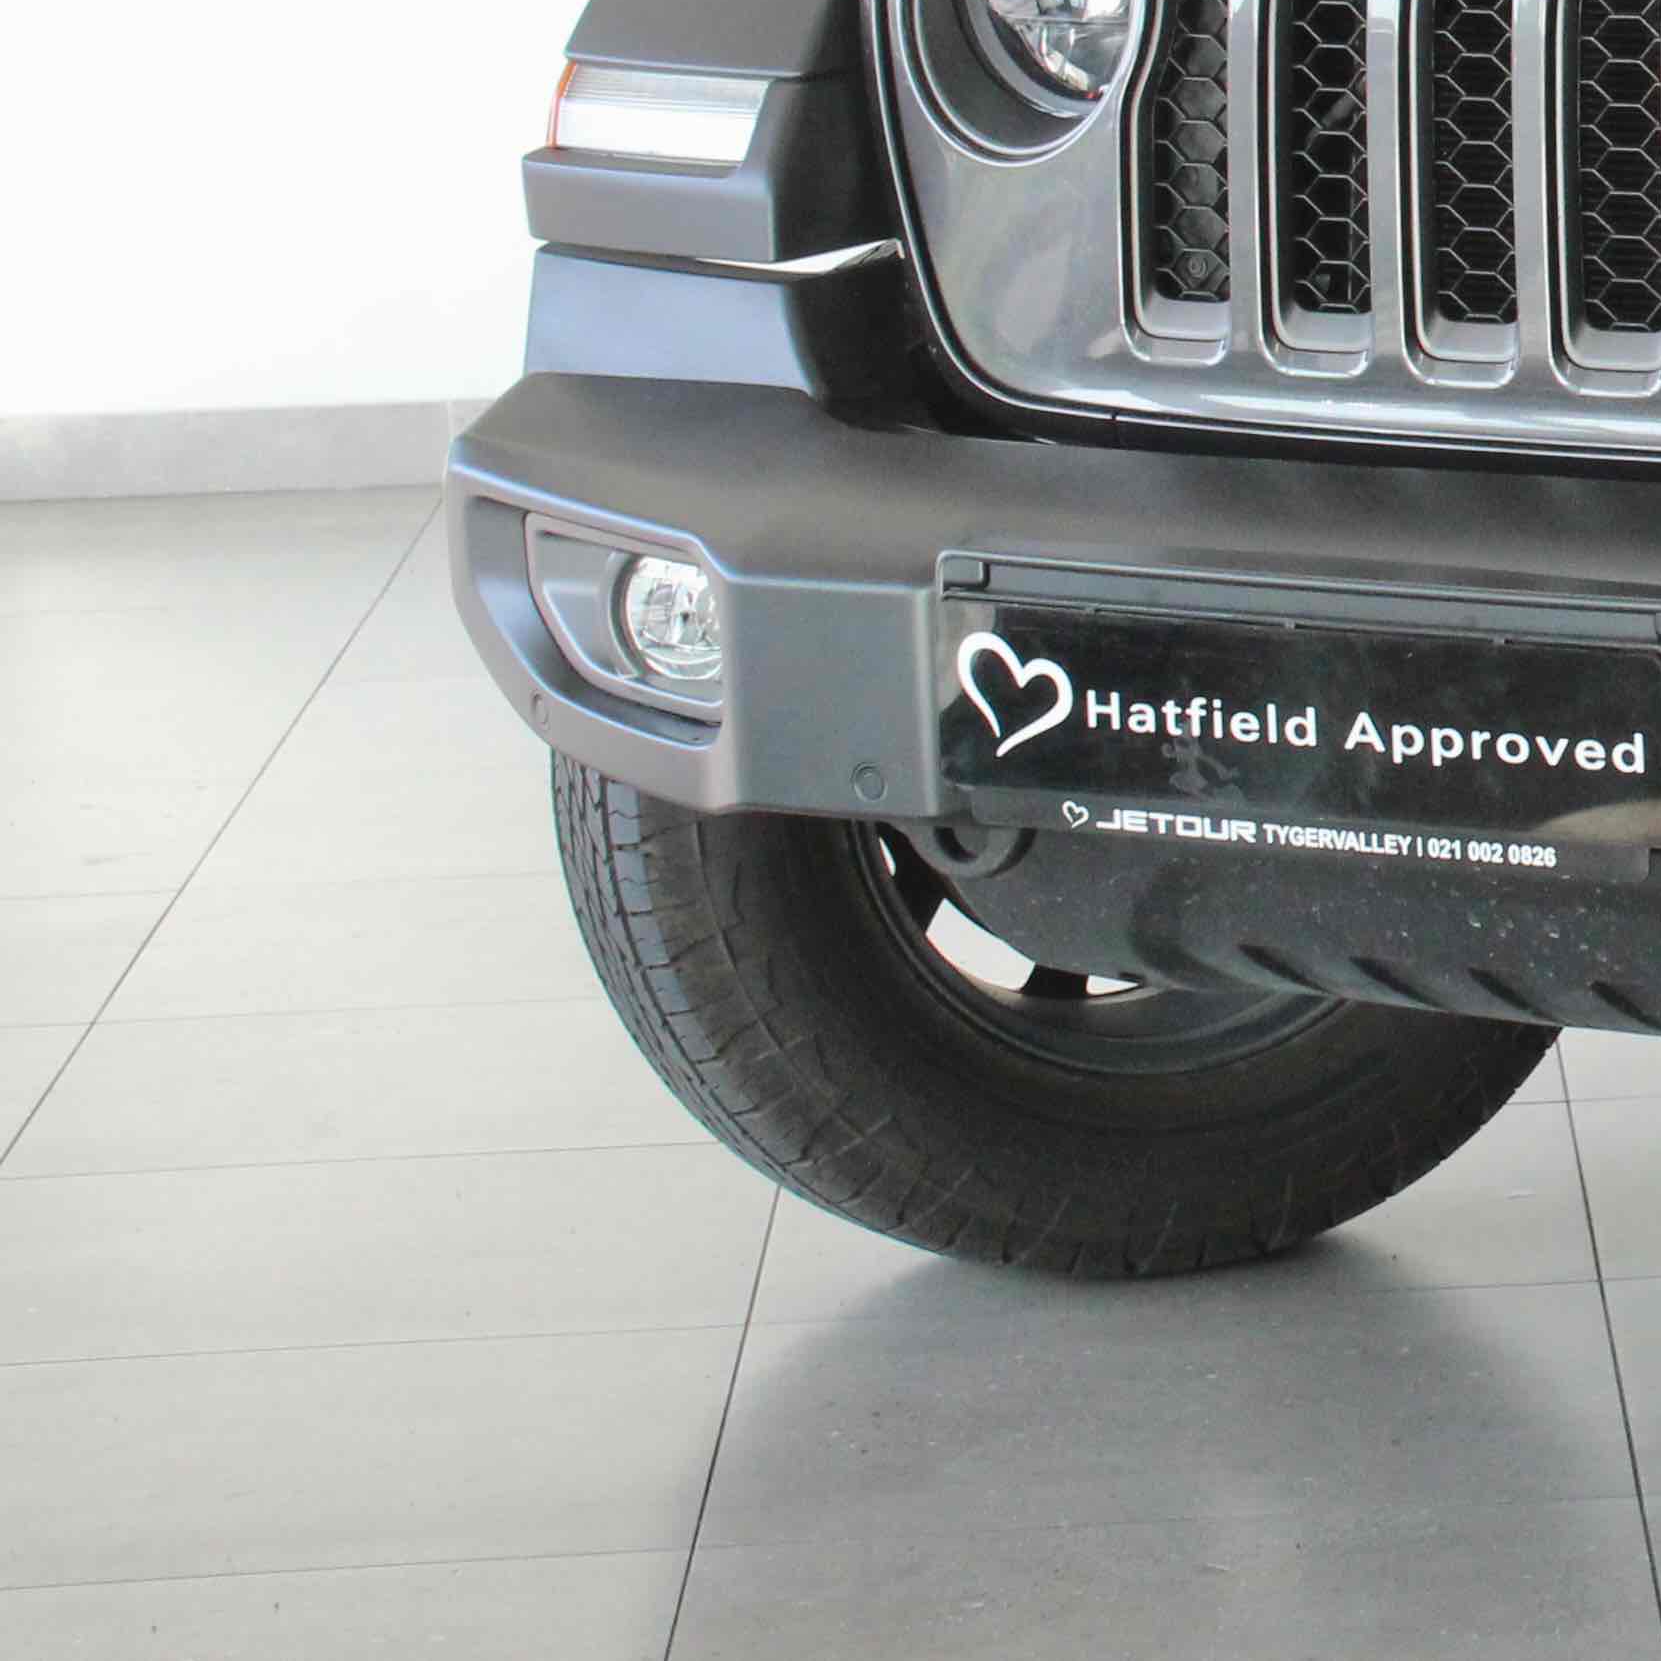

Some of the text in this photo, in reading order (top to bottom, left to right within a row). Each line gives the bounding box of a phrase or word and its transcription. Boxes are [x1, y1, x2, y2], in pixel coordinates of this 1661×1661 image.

[1086, 689, 1645, 774] Hatfield Approved
[1095, 808, 1257, 844] JETOUR
[1261, 823, 1413, 856] TYGERVALLEY
[1426, 837, 1462, 860] 021
[1467, 840, 1504, 864] 002
[1507, 843, 1557, 868] 0826
